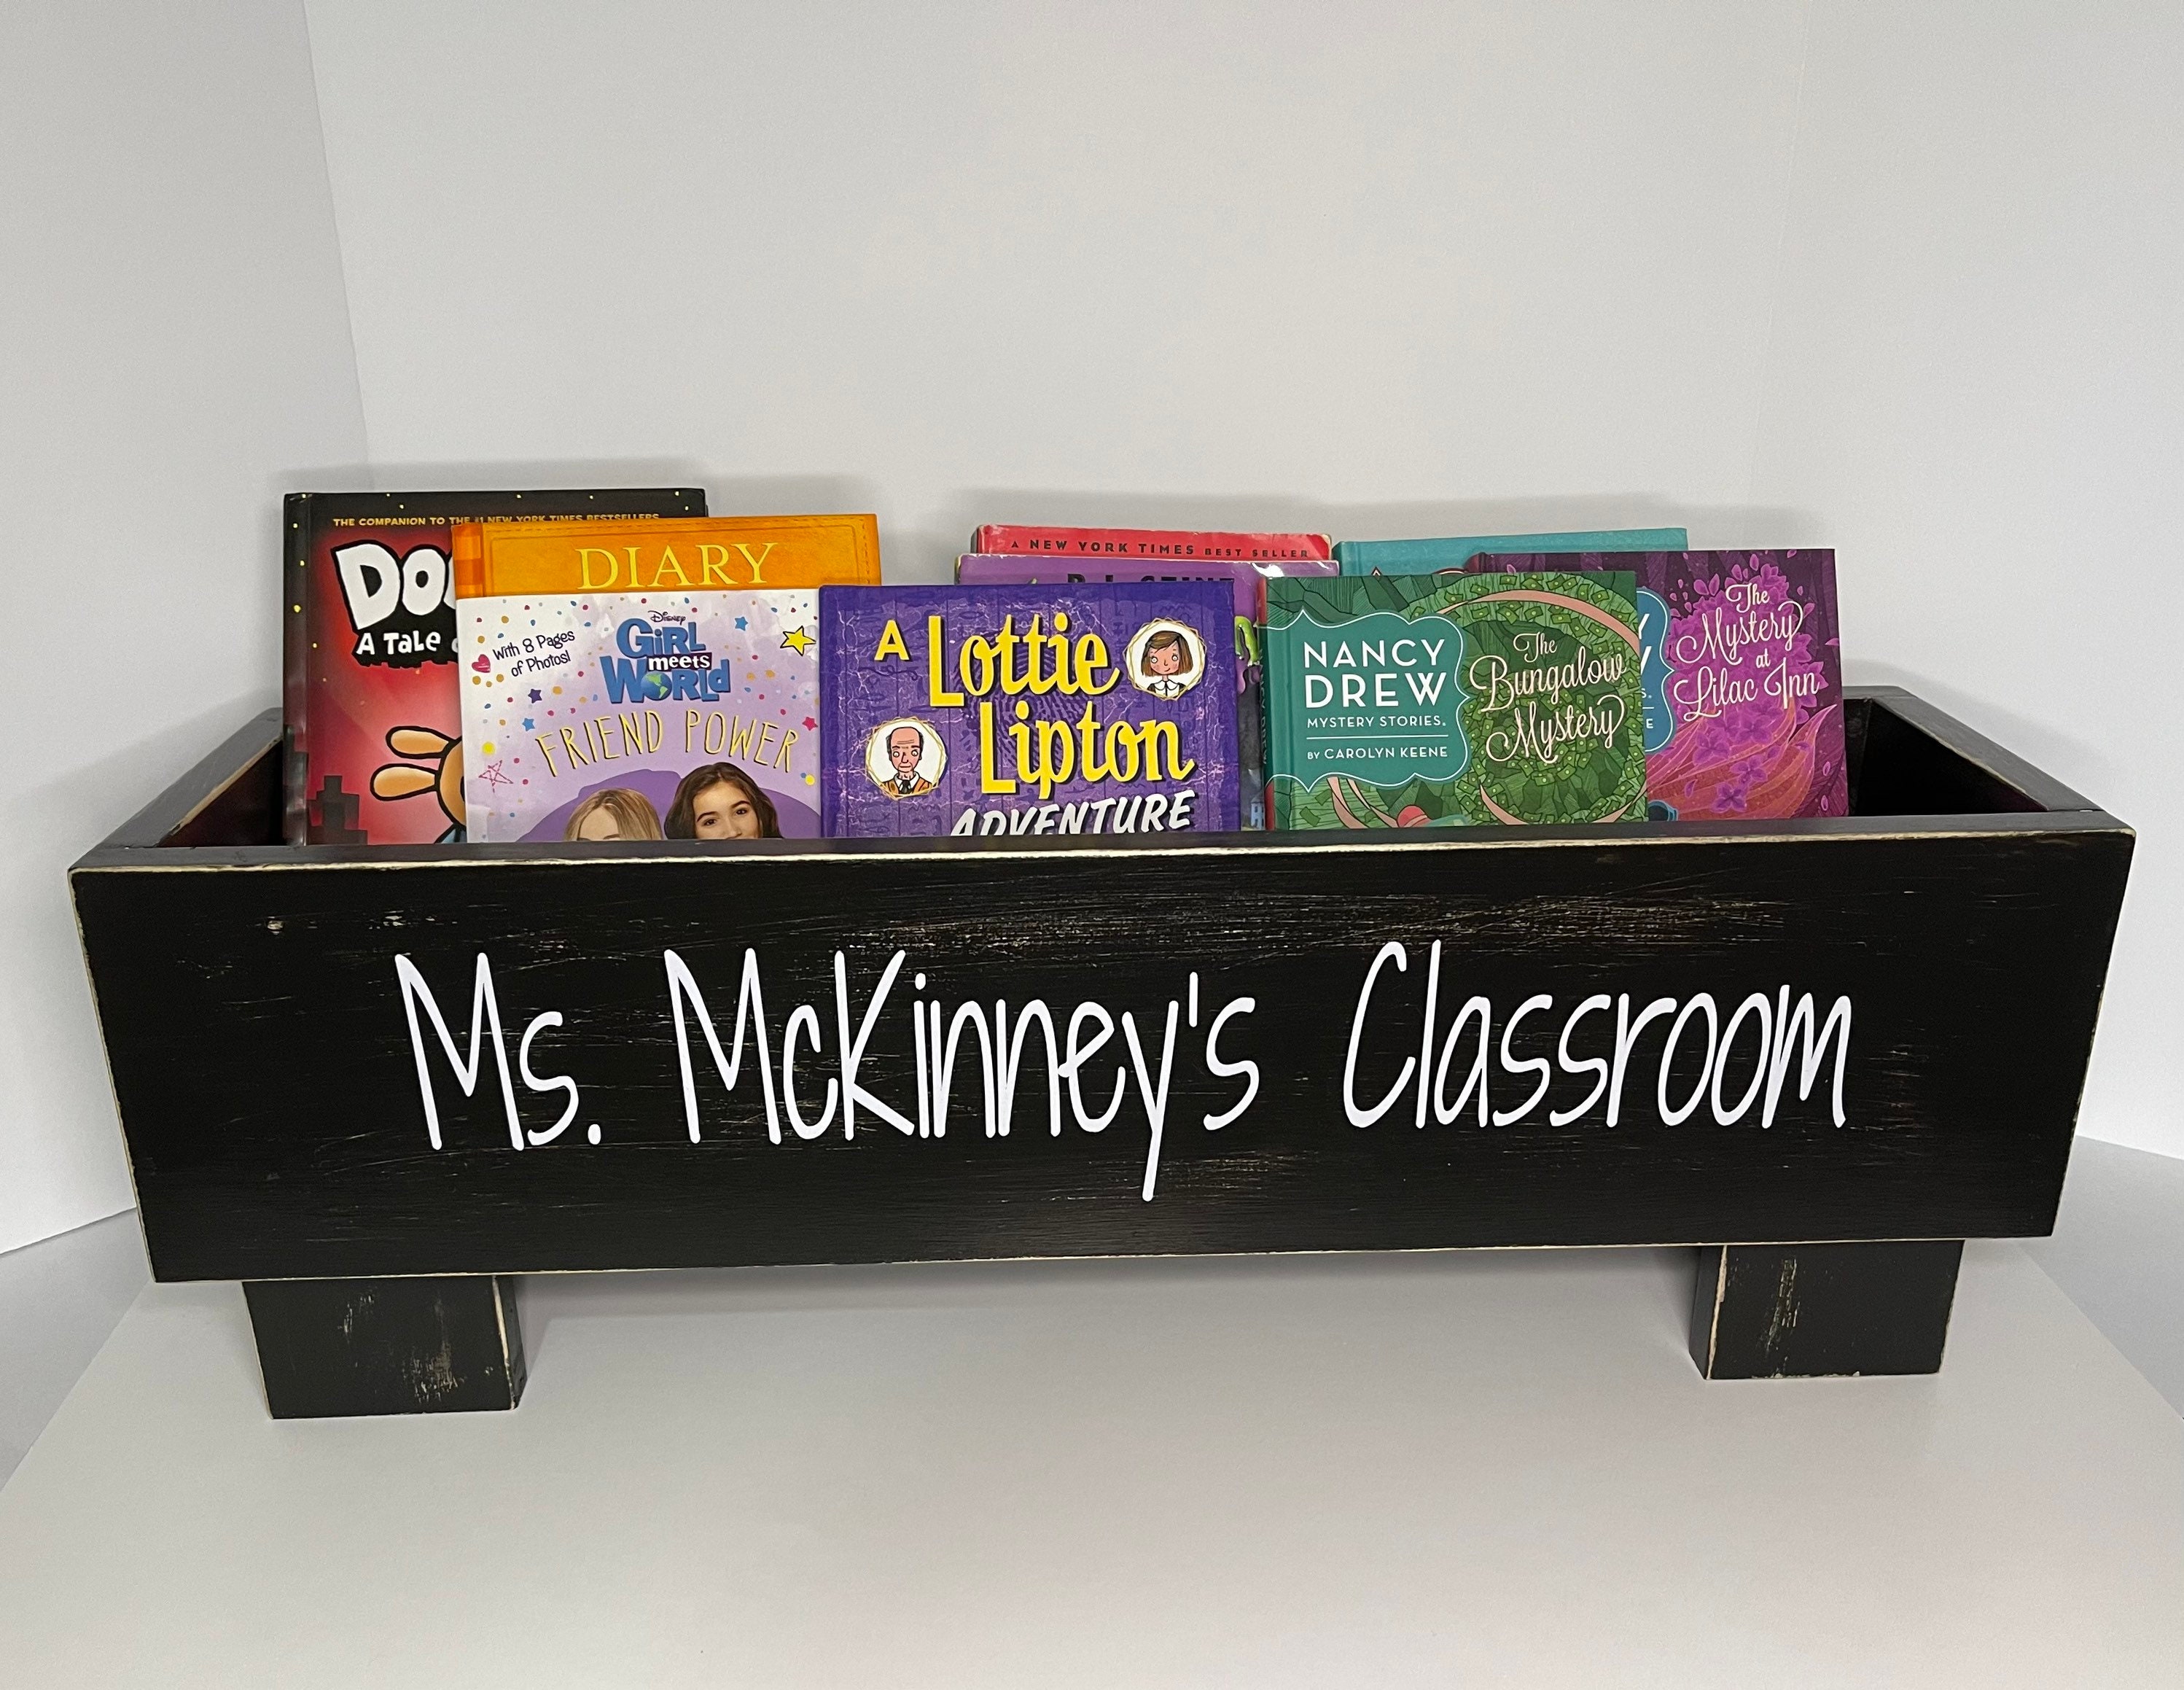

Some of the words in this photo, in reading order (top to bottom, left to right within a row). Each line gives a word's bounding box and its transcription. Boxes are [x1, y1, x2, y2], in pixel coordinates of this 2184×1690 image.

[333, 518, 355, 526] THE
[359, 517, 426, 526] COMPANION
[429, 517, 445, 525] TO
[449, 516, 470, 524] THE
[488, 515, 512, 523] NEW
[1011, 540, 1019, 548] A
[1030, 540, 1067, 550] NEW
[1078, 541, 1128, 553] YORK
[1138, 543, 1194, 555] TIMES
[1205, 548, 1241, 556] BEST
[1252, 550, 1308, 558] SELLER
[575, 542, 778, 589] DIARY
[1725, 583, 1769, 613] The
[356, 632, 375, 655] A
[493, 642, 520, 661] With
[523, 638, 534, 653] 8
[536, 631, 575, 649] Pages
[1513, 631, 1557, 663] The
[1676, 600, 1803, 666] Mystery
[511, 660, 524, 677] of
[526, 650, 572, 673] Photos!
[648, 655, 711, 671] meets
[874, 620, 910, 661] A
[928, 612, 1120, 707] Lottie
[1303, 639, 1445, 669] NANCY
[1756, 649, 1771, 668] at
[1305, 672, 1447, 709] DREW
[1470, 646, 1626, 712] Bungalow
[1674, 666, 1758, 722] Lilac
[1764, 658, 1820, 709] Inn
[1307, 716, 1374, 728] MYSTERY
[1486, 694, 1625, 764] Mystery
[535, 709, 663, 777] FRIEND
[685, 709, 799, 773] POWER
[980, 700, 1196, 800] Lipton
[1307, 752, 1320, 760] BY
[1325, 747, 1395, 760] CAROLYN
[1400, 746, 1448, 758] KEENE
[950, 790, 1196, 836] ADVENTURE
[394, 952, 601, 1150] Ms.
[663, 947, 1260, 1202] McKinney's
[1343, 939, 1852, 1129] Classroom
